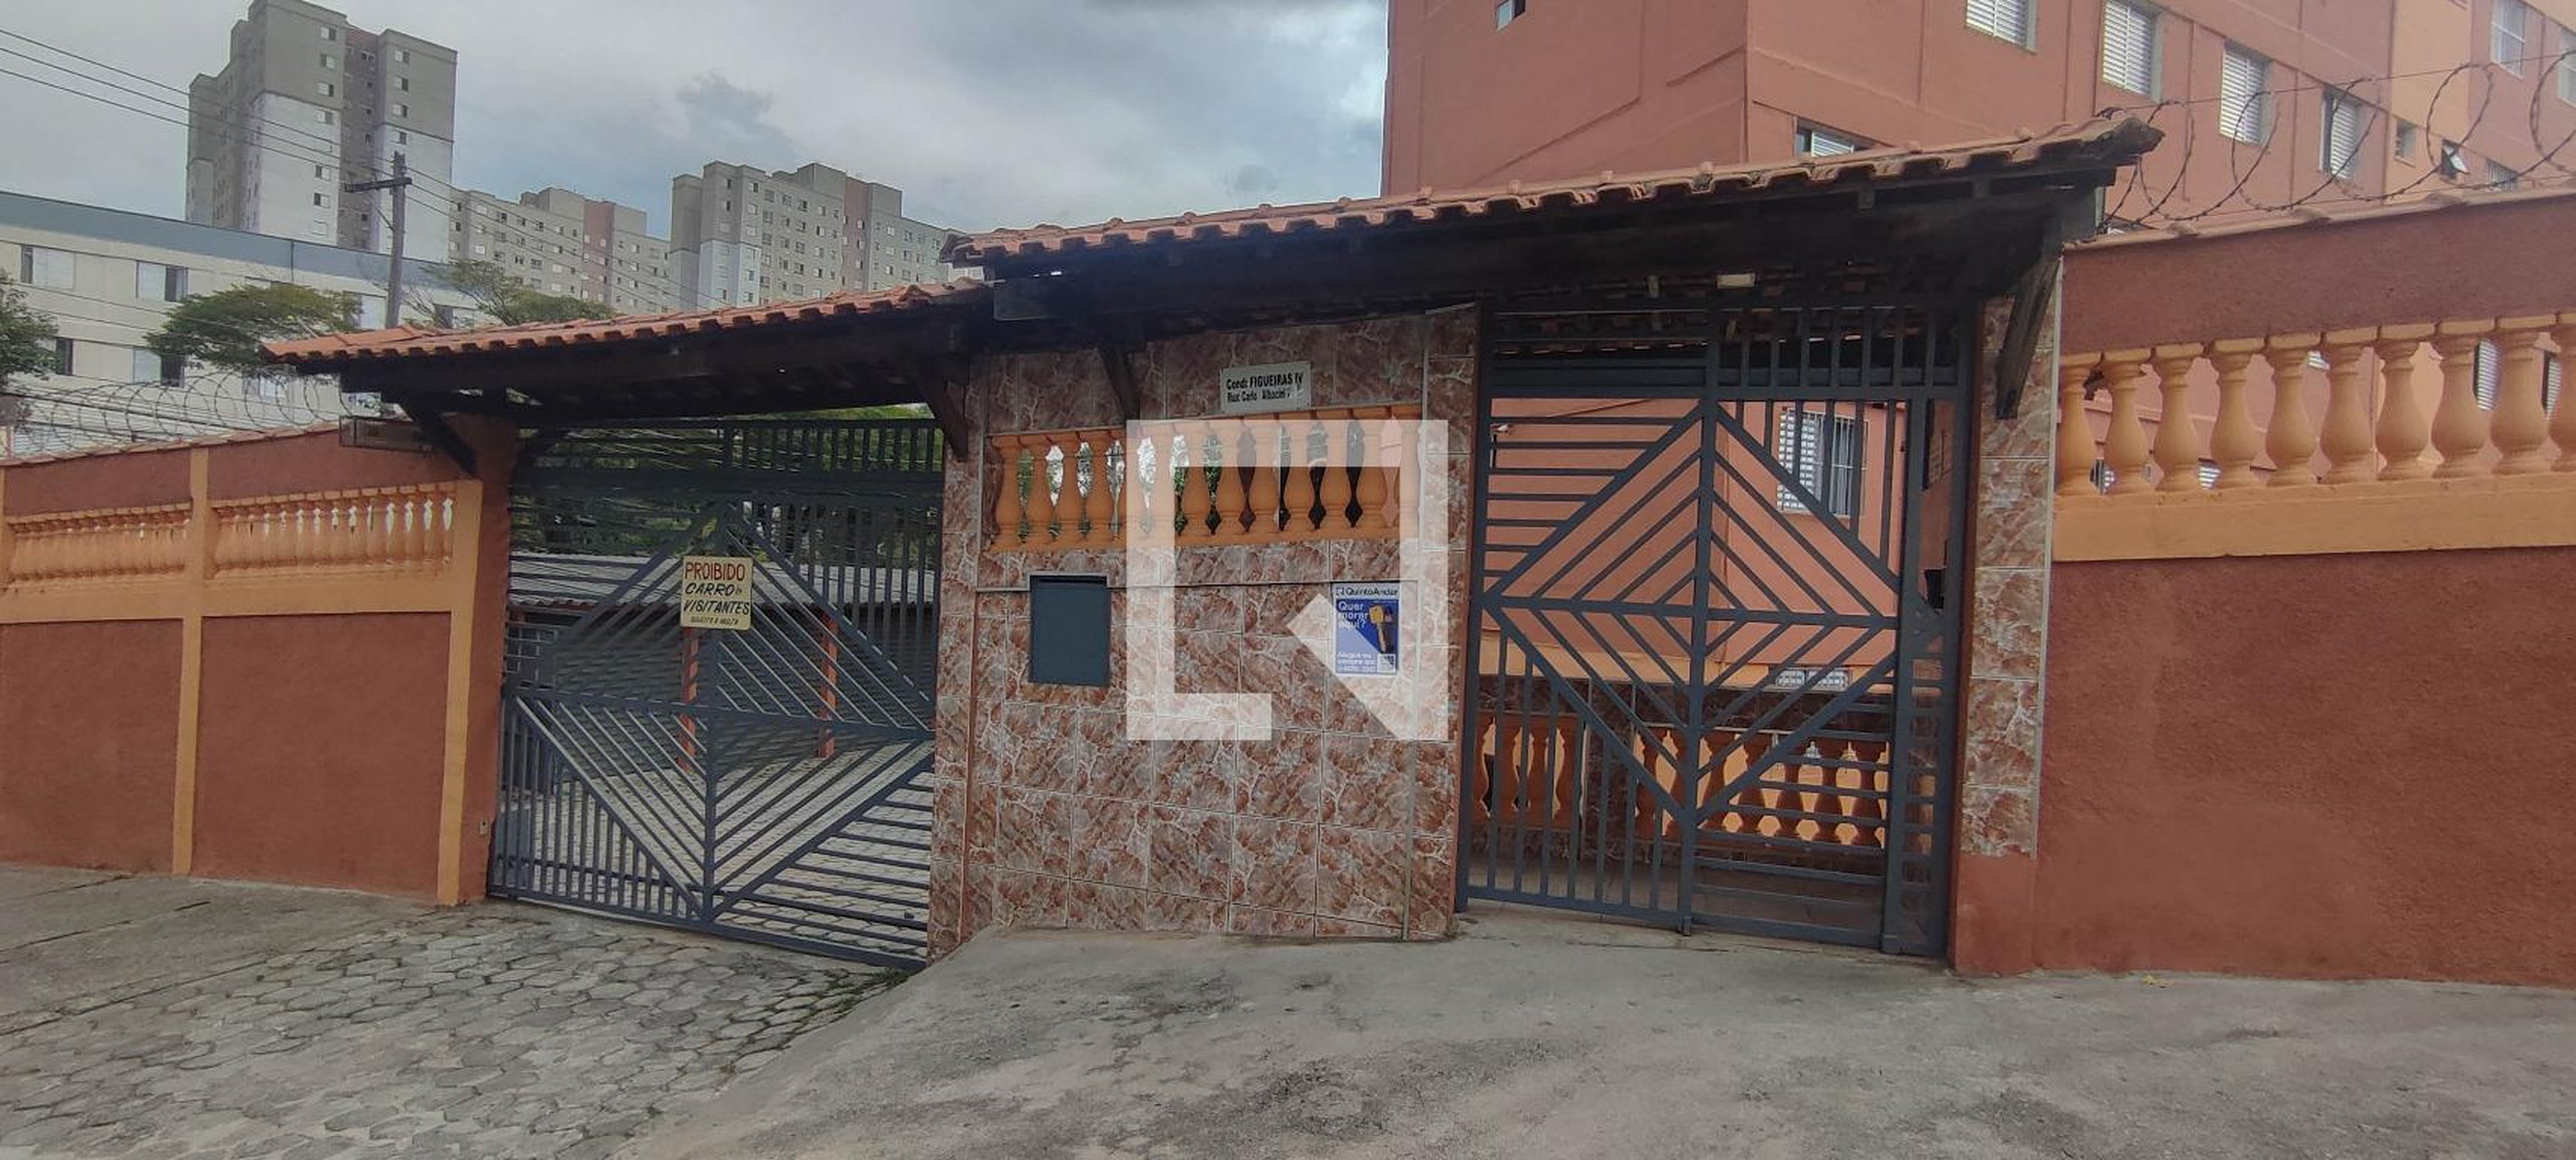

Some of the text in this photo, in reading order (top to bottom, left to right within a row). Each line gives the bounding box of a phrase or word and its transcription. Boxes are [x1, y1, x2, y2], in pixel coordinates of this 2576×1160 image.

[1249, 372, 1293, 388] FIGUEIRAS
[685, 562, 746, 581] PROIBIDO
[685, 582, 735, 596] CARRO
[684, 599, 750, 615] VISITANTES
